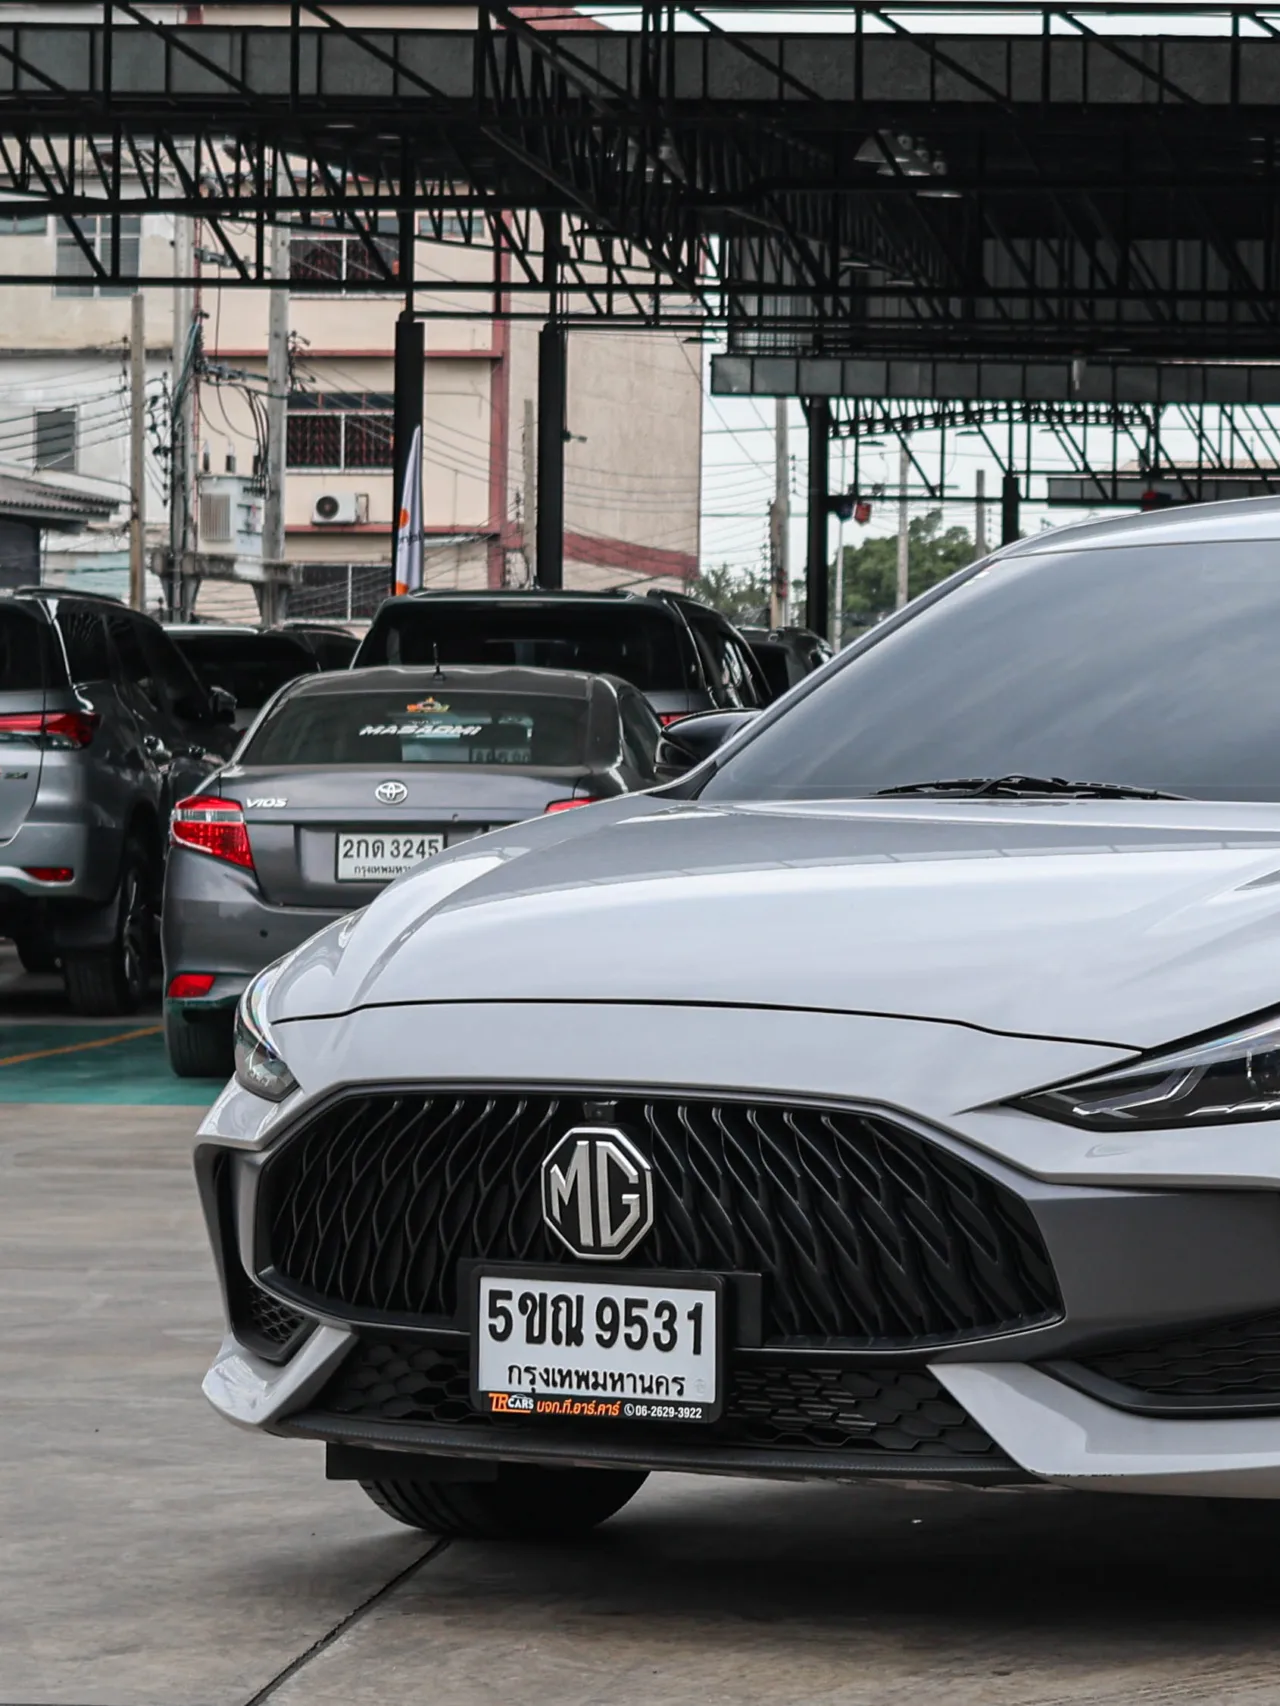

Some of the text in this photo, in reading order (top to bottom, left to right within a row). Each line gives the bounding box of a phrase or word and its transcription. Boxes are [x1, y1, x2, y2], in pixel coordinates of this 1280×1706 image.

[246, 797, 288, 808] VIOS
[343, 838, 439, 859] 2กด 3245
[550, 1140, 640, 1247] MG
[488, 1289, 704, 1356] 5ขณ 9531
[507, 1364, 686, 1396] กรุงเทพมหานคร
[635, 1405, 702, 1419] 06-2629-3922
